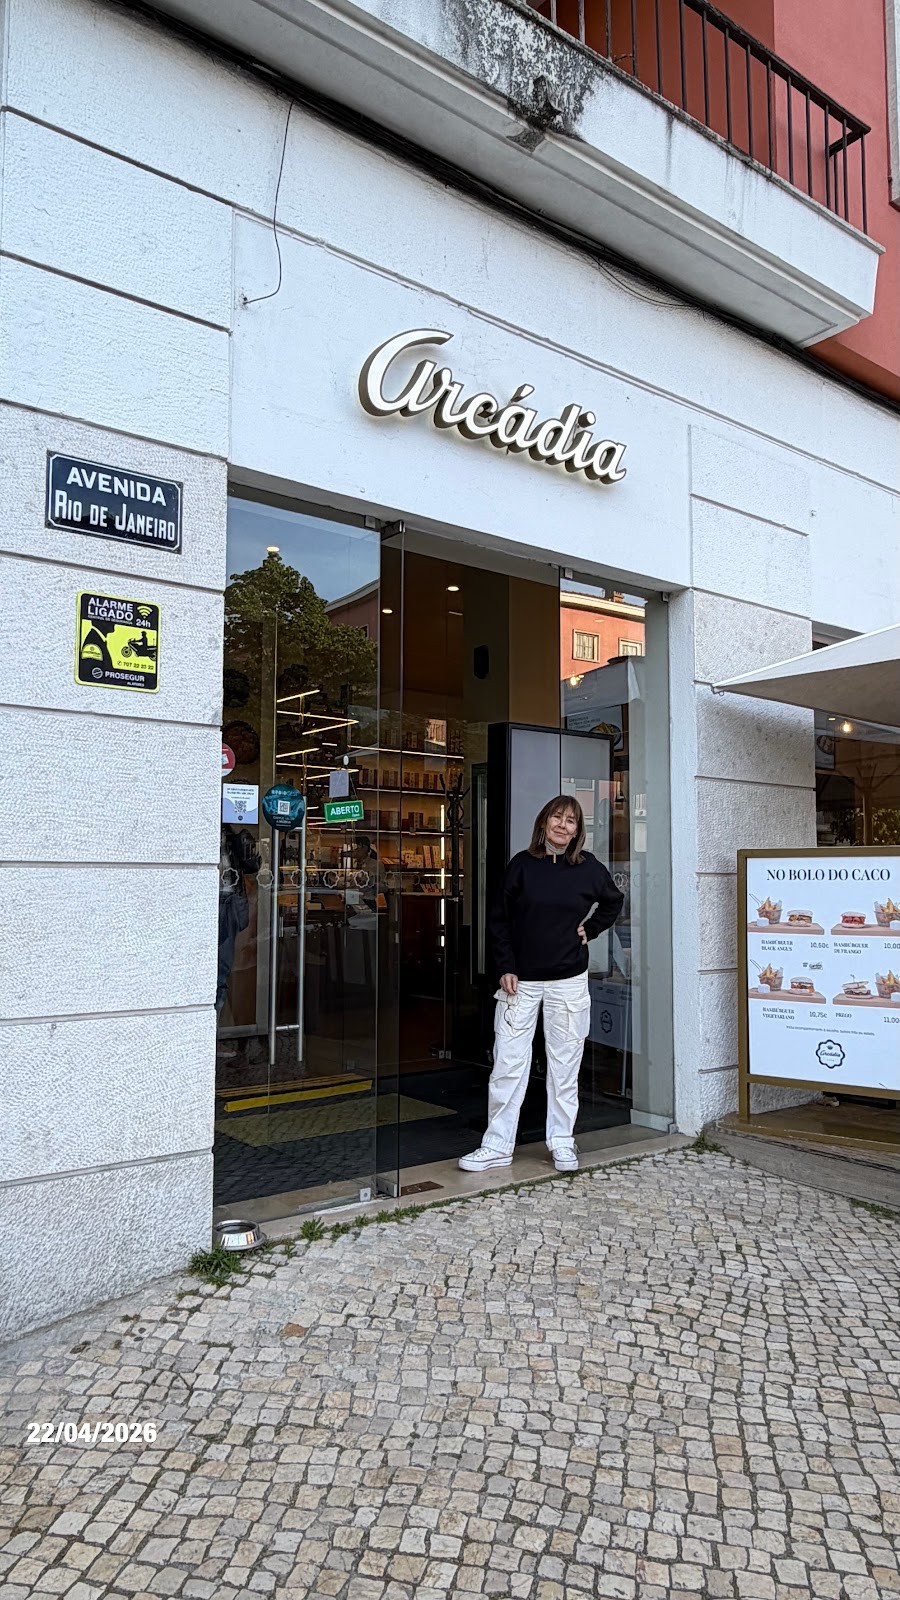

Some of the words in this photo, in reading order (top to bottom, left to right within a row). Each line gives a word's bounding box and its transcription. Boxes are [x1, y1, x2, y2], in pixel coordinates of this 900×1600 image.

[358, 328, 627, 485] Arcádia
[66, 466, 167, 507] AVENIDA
[89, 504, 109, 528] DE
[88, 597, 134, 612] ALARME
[87, 606, 134, 621] LIGADO
[135, 618, 151, 628] 24h
[104, 670, 145, 682] PROSEGUR
[330, 804, 360, 816] ABERTO
[766, 868, 786, 881] NO
[788, 868, 825, 881] BOLO
[828, 868, 849, 881] DO
[852, 868, 891, 881] CACO
